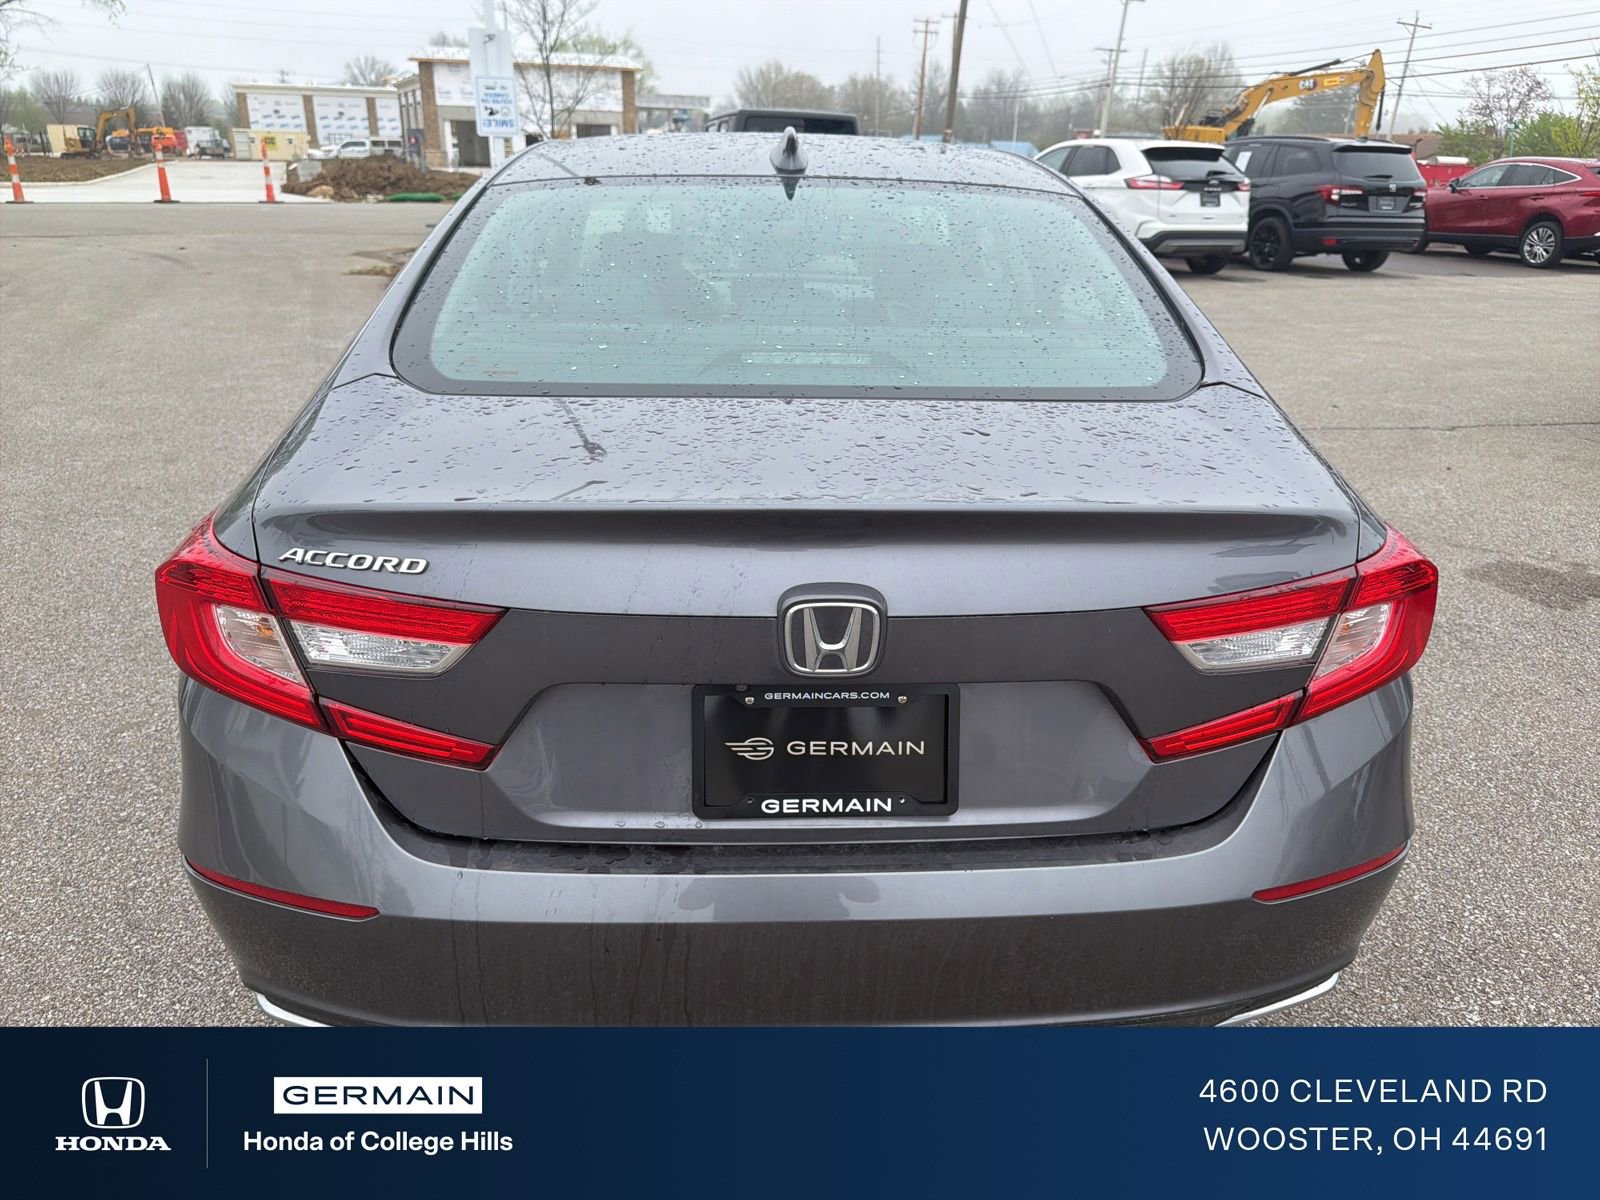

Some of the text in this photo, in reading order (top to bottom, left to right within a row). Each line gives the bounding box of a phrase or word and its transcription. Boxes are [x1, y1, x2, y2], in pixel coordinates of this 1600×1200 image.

[483, 119, 514, 128] SMILE!
[278, 547, 427, 575] ACCORD
[764, 691, 890, 700] GERMAINCARS.COM
[786, 740, 925, 756] GERMAIN
[760, 797, 892, 814] GERMAIN
